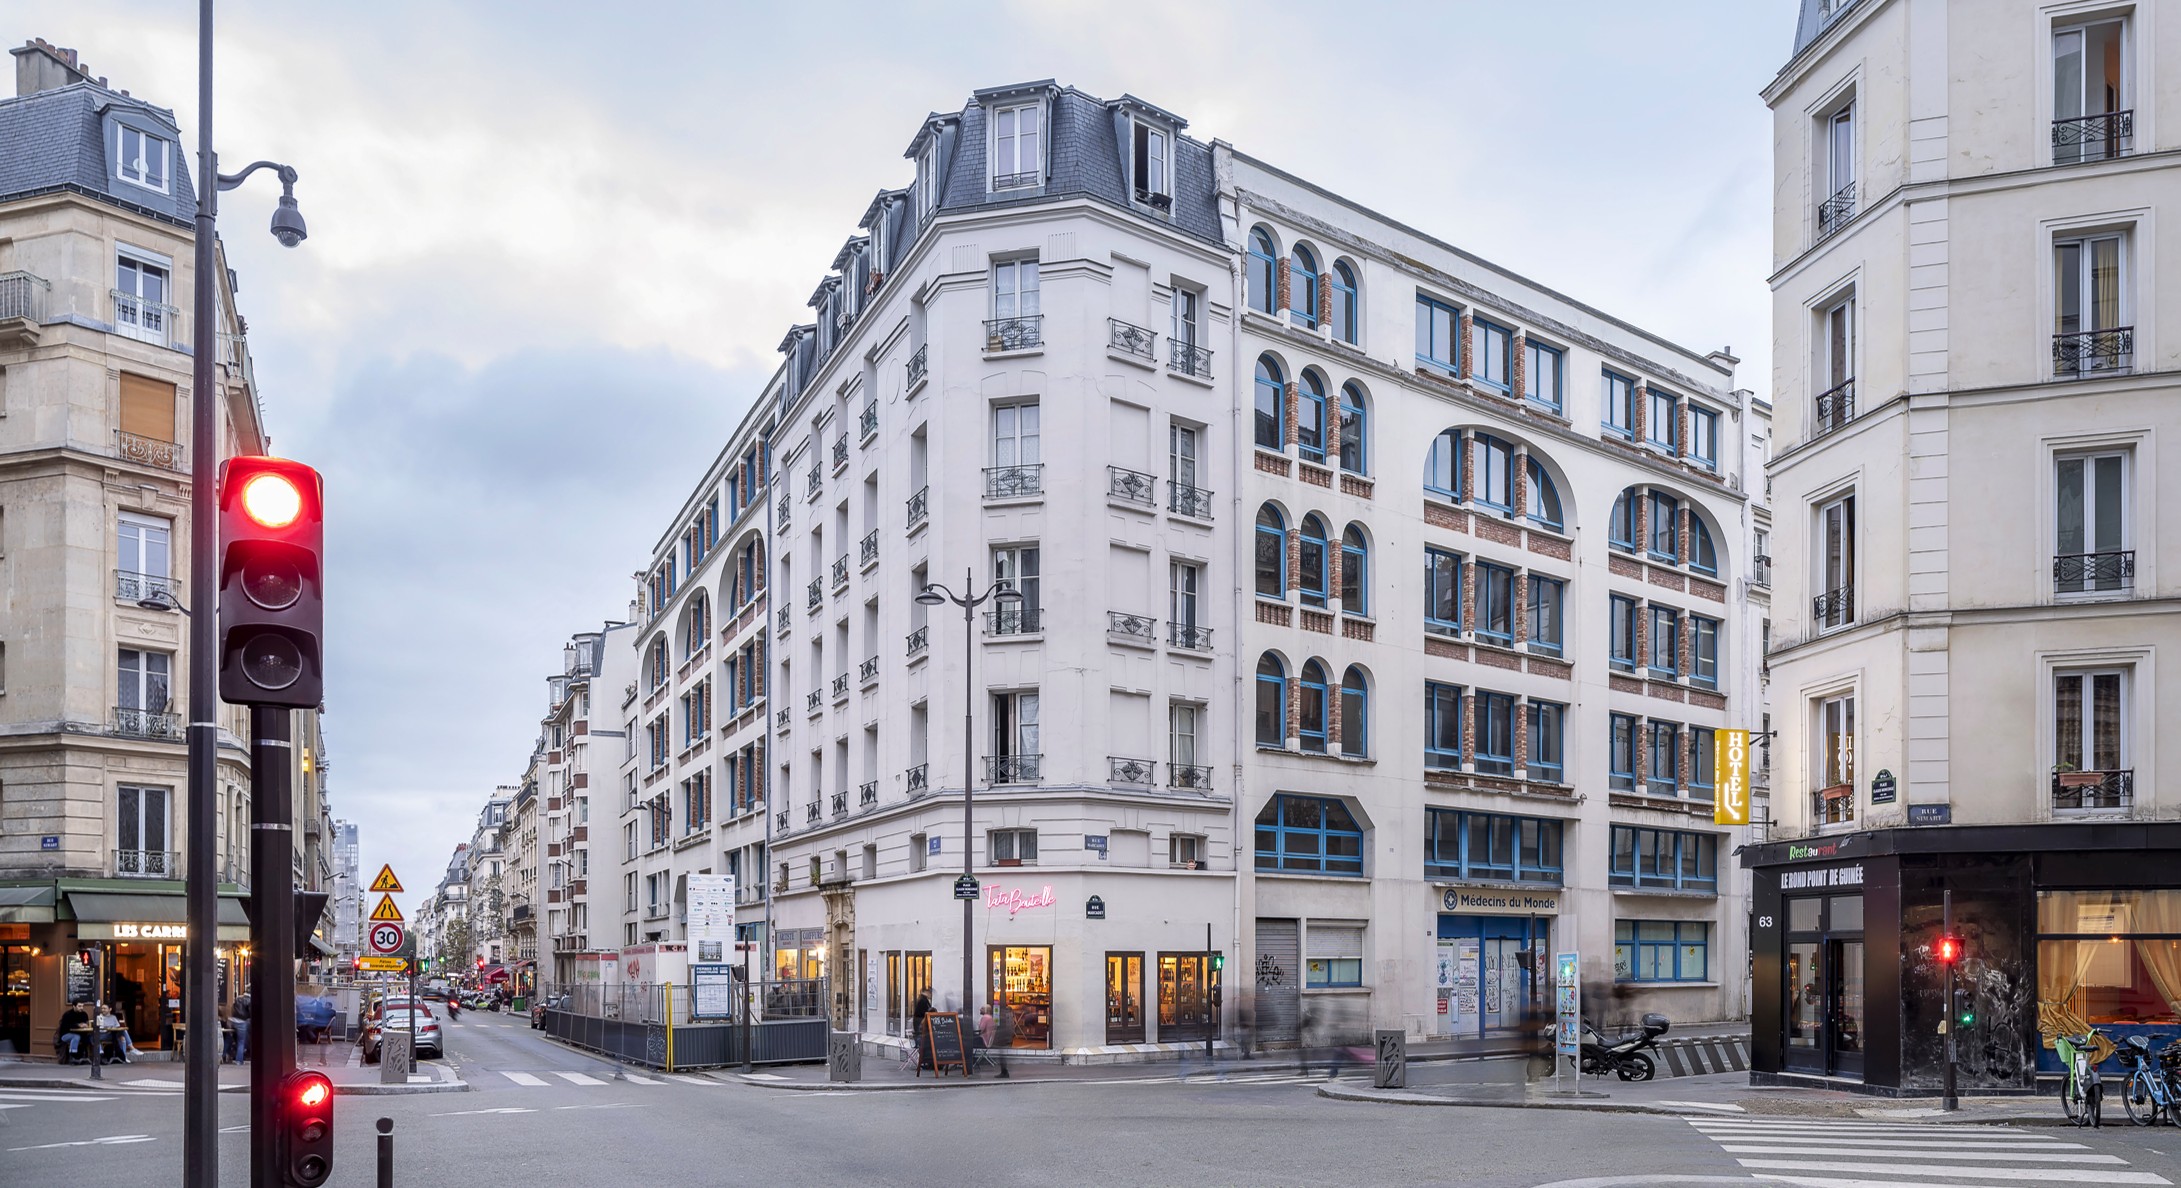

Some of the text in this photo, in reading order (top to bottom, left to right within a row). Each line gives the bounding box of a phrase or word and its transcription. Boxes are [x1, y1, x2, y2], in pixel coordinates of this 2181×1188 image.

[1728, 732, 1743, 807] HOTEL
[1789, 842, 1838, 861] Restaurant
[1781, 863, 1864, 889] LE ROND POINT DE GUINÉE
[982, 884, 1010, 909] Tata
[1461, 894, 1555, 909] Médecins du Monde
[113, 924, 138, 937] LES
[1759, 916, 1773, 928] 63
[376, 931, 397, 945] 30
